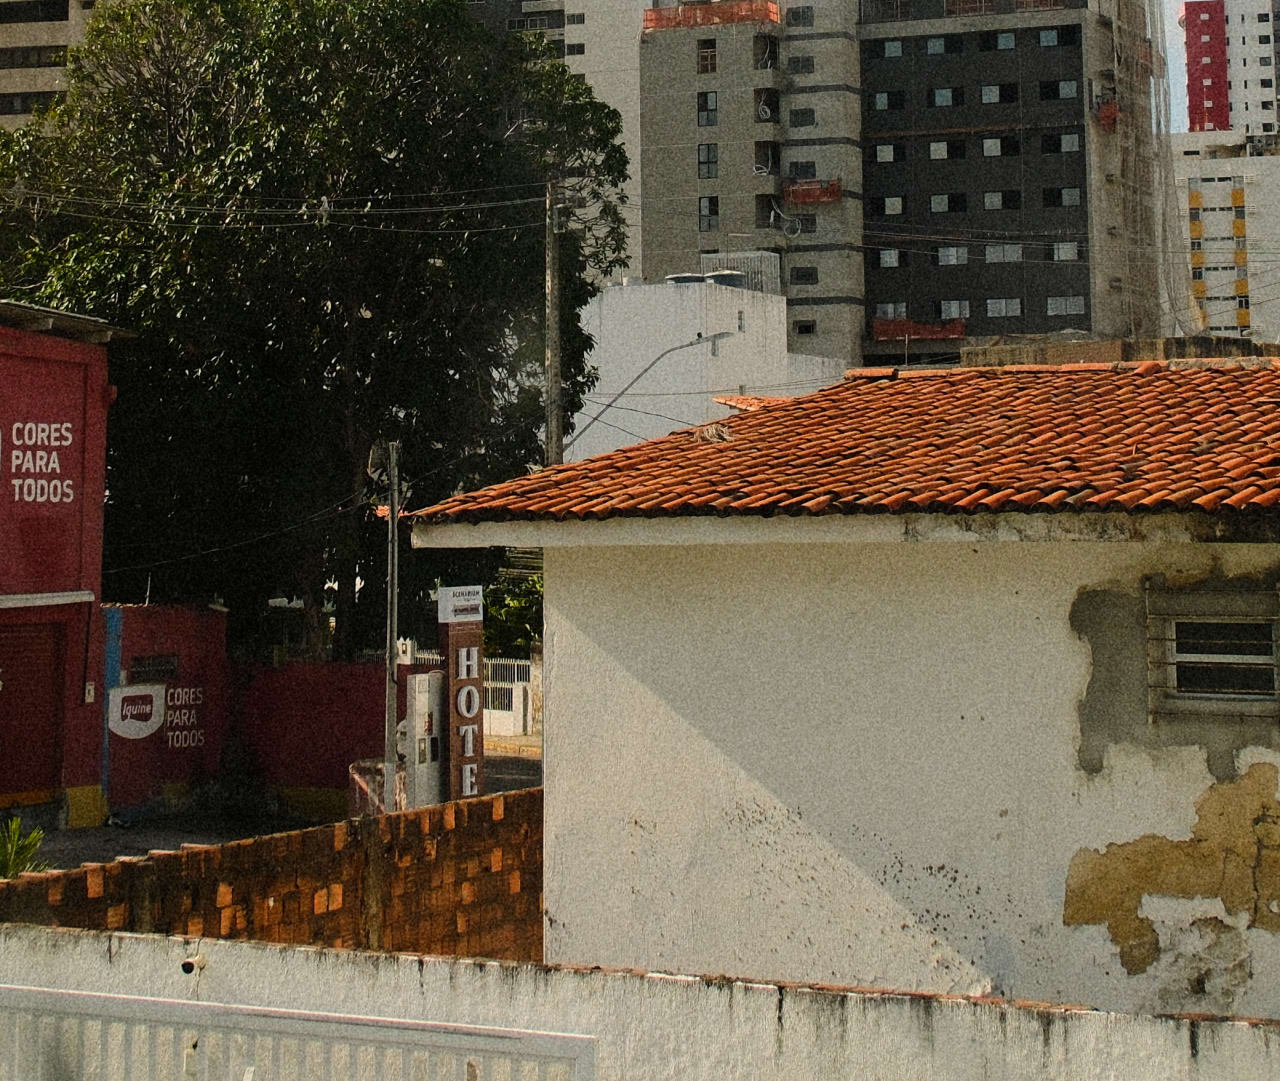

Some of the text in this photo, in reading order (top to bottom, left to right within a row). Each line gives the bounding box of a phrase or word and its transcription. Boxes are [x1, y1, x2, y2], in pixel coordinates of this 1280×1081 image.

[12, 422, 73, 446] CORES
[11, 450, 61, 473] PARA
[11, 478, 74, 503] TODOS
[167, 687, 204, 706] CORES
[122, 702, 151, 720] Iquine
[167, 710, 197, 727] PARA
[457, 646, 480, 796] HOTE
[167, 730, 205, 749] TODOS
